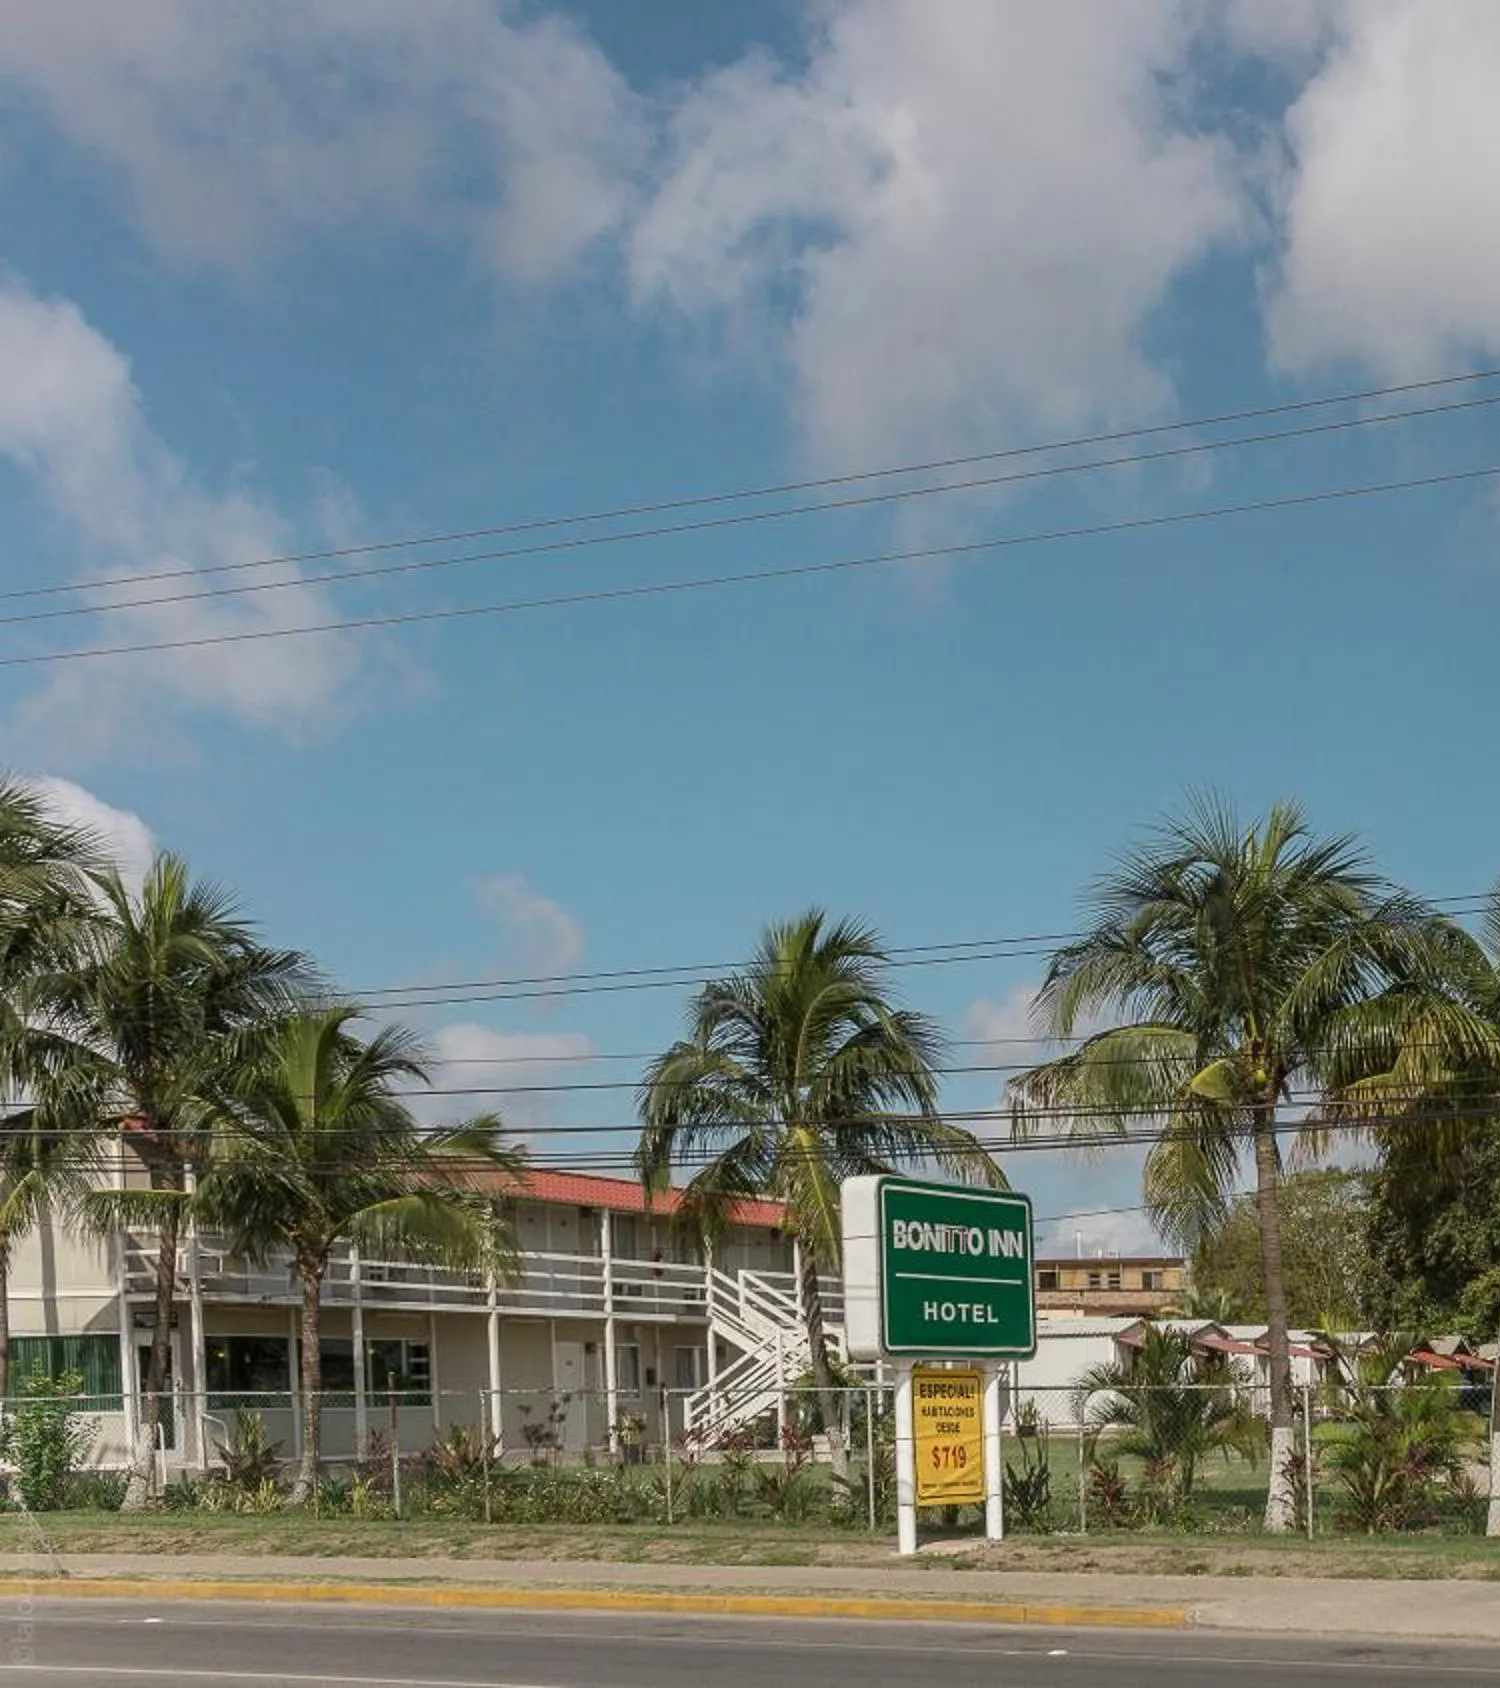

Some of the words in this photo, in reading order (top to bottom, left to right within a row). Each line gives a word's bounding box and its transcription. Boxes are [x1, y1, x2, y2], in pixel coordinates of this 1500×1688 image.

[893, 1219, 984, 1256] BONITTO
[989, 1229, 1024, 1259] INN
[923, 1301, 999, 1323] HOTEL
[931, 1445, 967, 1470] $719
